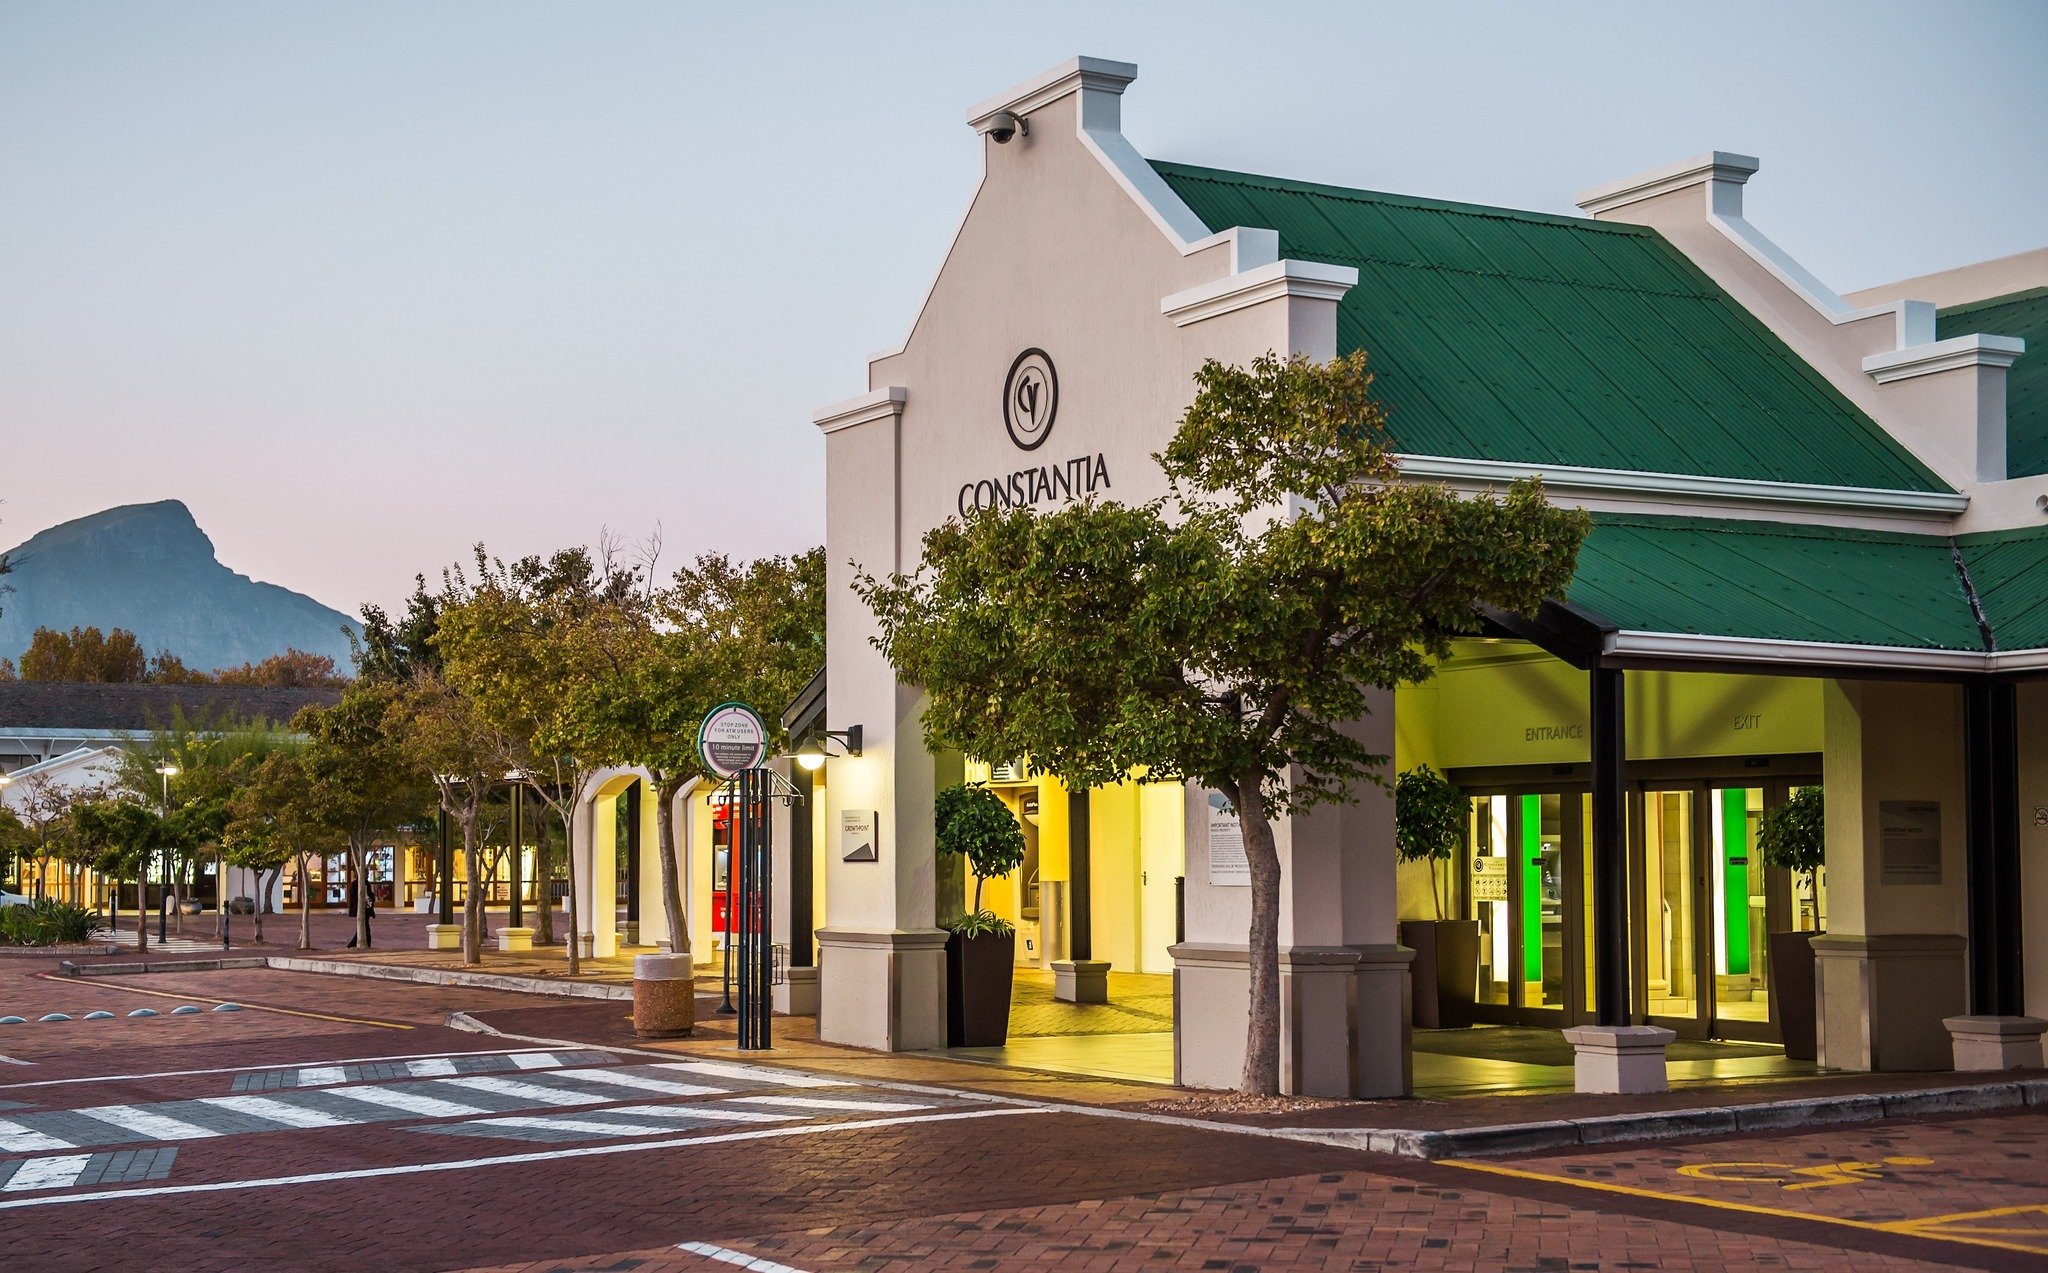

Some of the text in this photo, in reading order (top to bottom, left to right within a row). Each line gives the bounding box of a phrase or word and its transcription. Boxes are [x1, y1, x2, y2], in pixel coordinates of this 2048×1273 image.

[957, 452, 1112, 520] CONSTANTIA
[1732, 713, 1762, 731] EXIT
[1525, 724, 1584, 742] ENTRANCE
